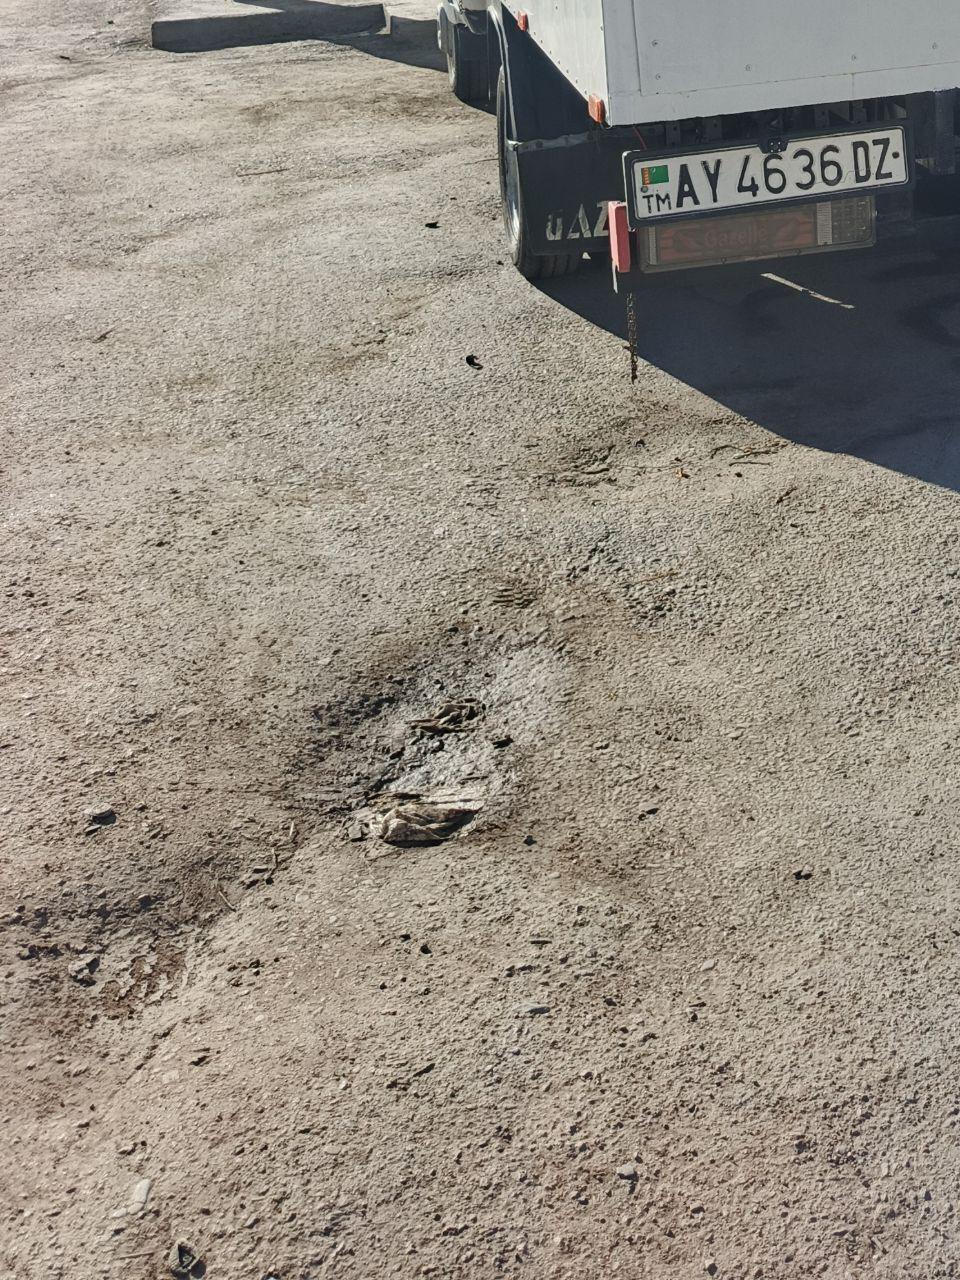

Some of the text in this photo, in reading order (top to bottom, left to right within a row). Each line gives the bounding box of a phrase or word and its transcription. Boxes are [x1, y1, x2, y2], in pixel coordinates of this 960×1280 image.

[642, 192, 672, 214] TM
[676, 158, 721, 208] AY
[852, 137, 893, 184] DZ
